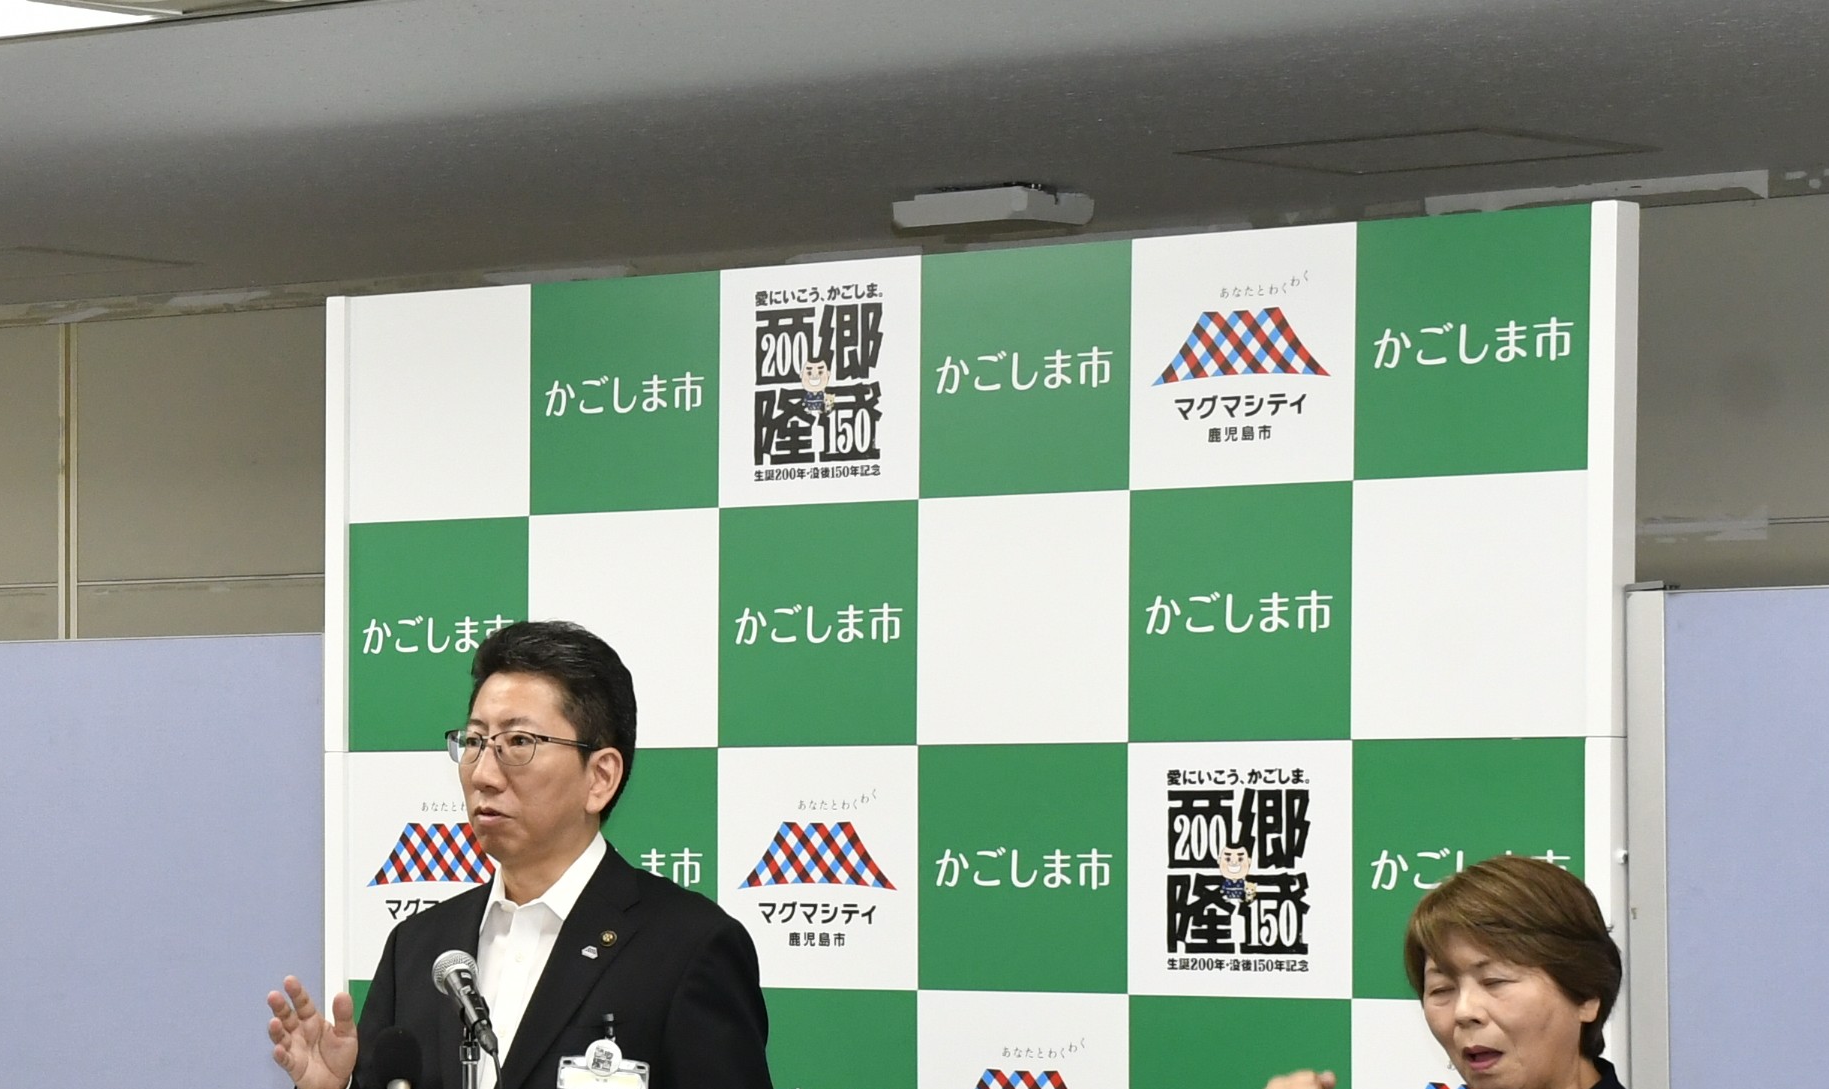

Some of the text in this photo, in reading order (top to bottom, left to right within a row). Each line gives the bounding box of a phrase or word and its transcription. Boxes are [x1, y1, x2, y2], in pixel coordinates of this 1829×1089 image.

[755, 283, 883, 307] 愛にいこう、かごしま。
[1220, 270, 1308, 298] あなたとわくわく
[761, 331, 809, 377] 200
[1374, 317, 1574, 368] かごしま市
[937, 346, 1113, 394] かごしま市
[546, 372, 704, 416] かごしま市
[1175, 394, 1306, 420] マグマシティ
[826, 408, 871, 454] 150
[1208, 425, 1271, 442] 鹿児島市
[736, 603, 902, 644] かごしま市
[1146, 590, 1333, 634] かごしま市
[1167, 768, 1309, 785] 愛にいこう、かごしま。
[421, 801, 466, 812] あなたと
[798, 789, 876, 810] あなたとわくわく
[1174, 814, 1224, 861] 200
[936, 847, 1112, 889] かごしま市
[759, 902, 876, 924] マグマシティ
[1246, 901, 1298, 947] 150
[789, 932, 845, 946] 鹿児島市
[1002, 1038, 1084, 1058] あなたとわくわく
